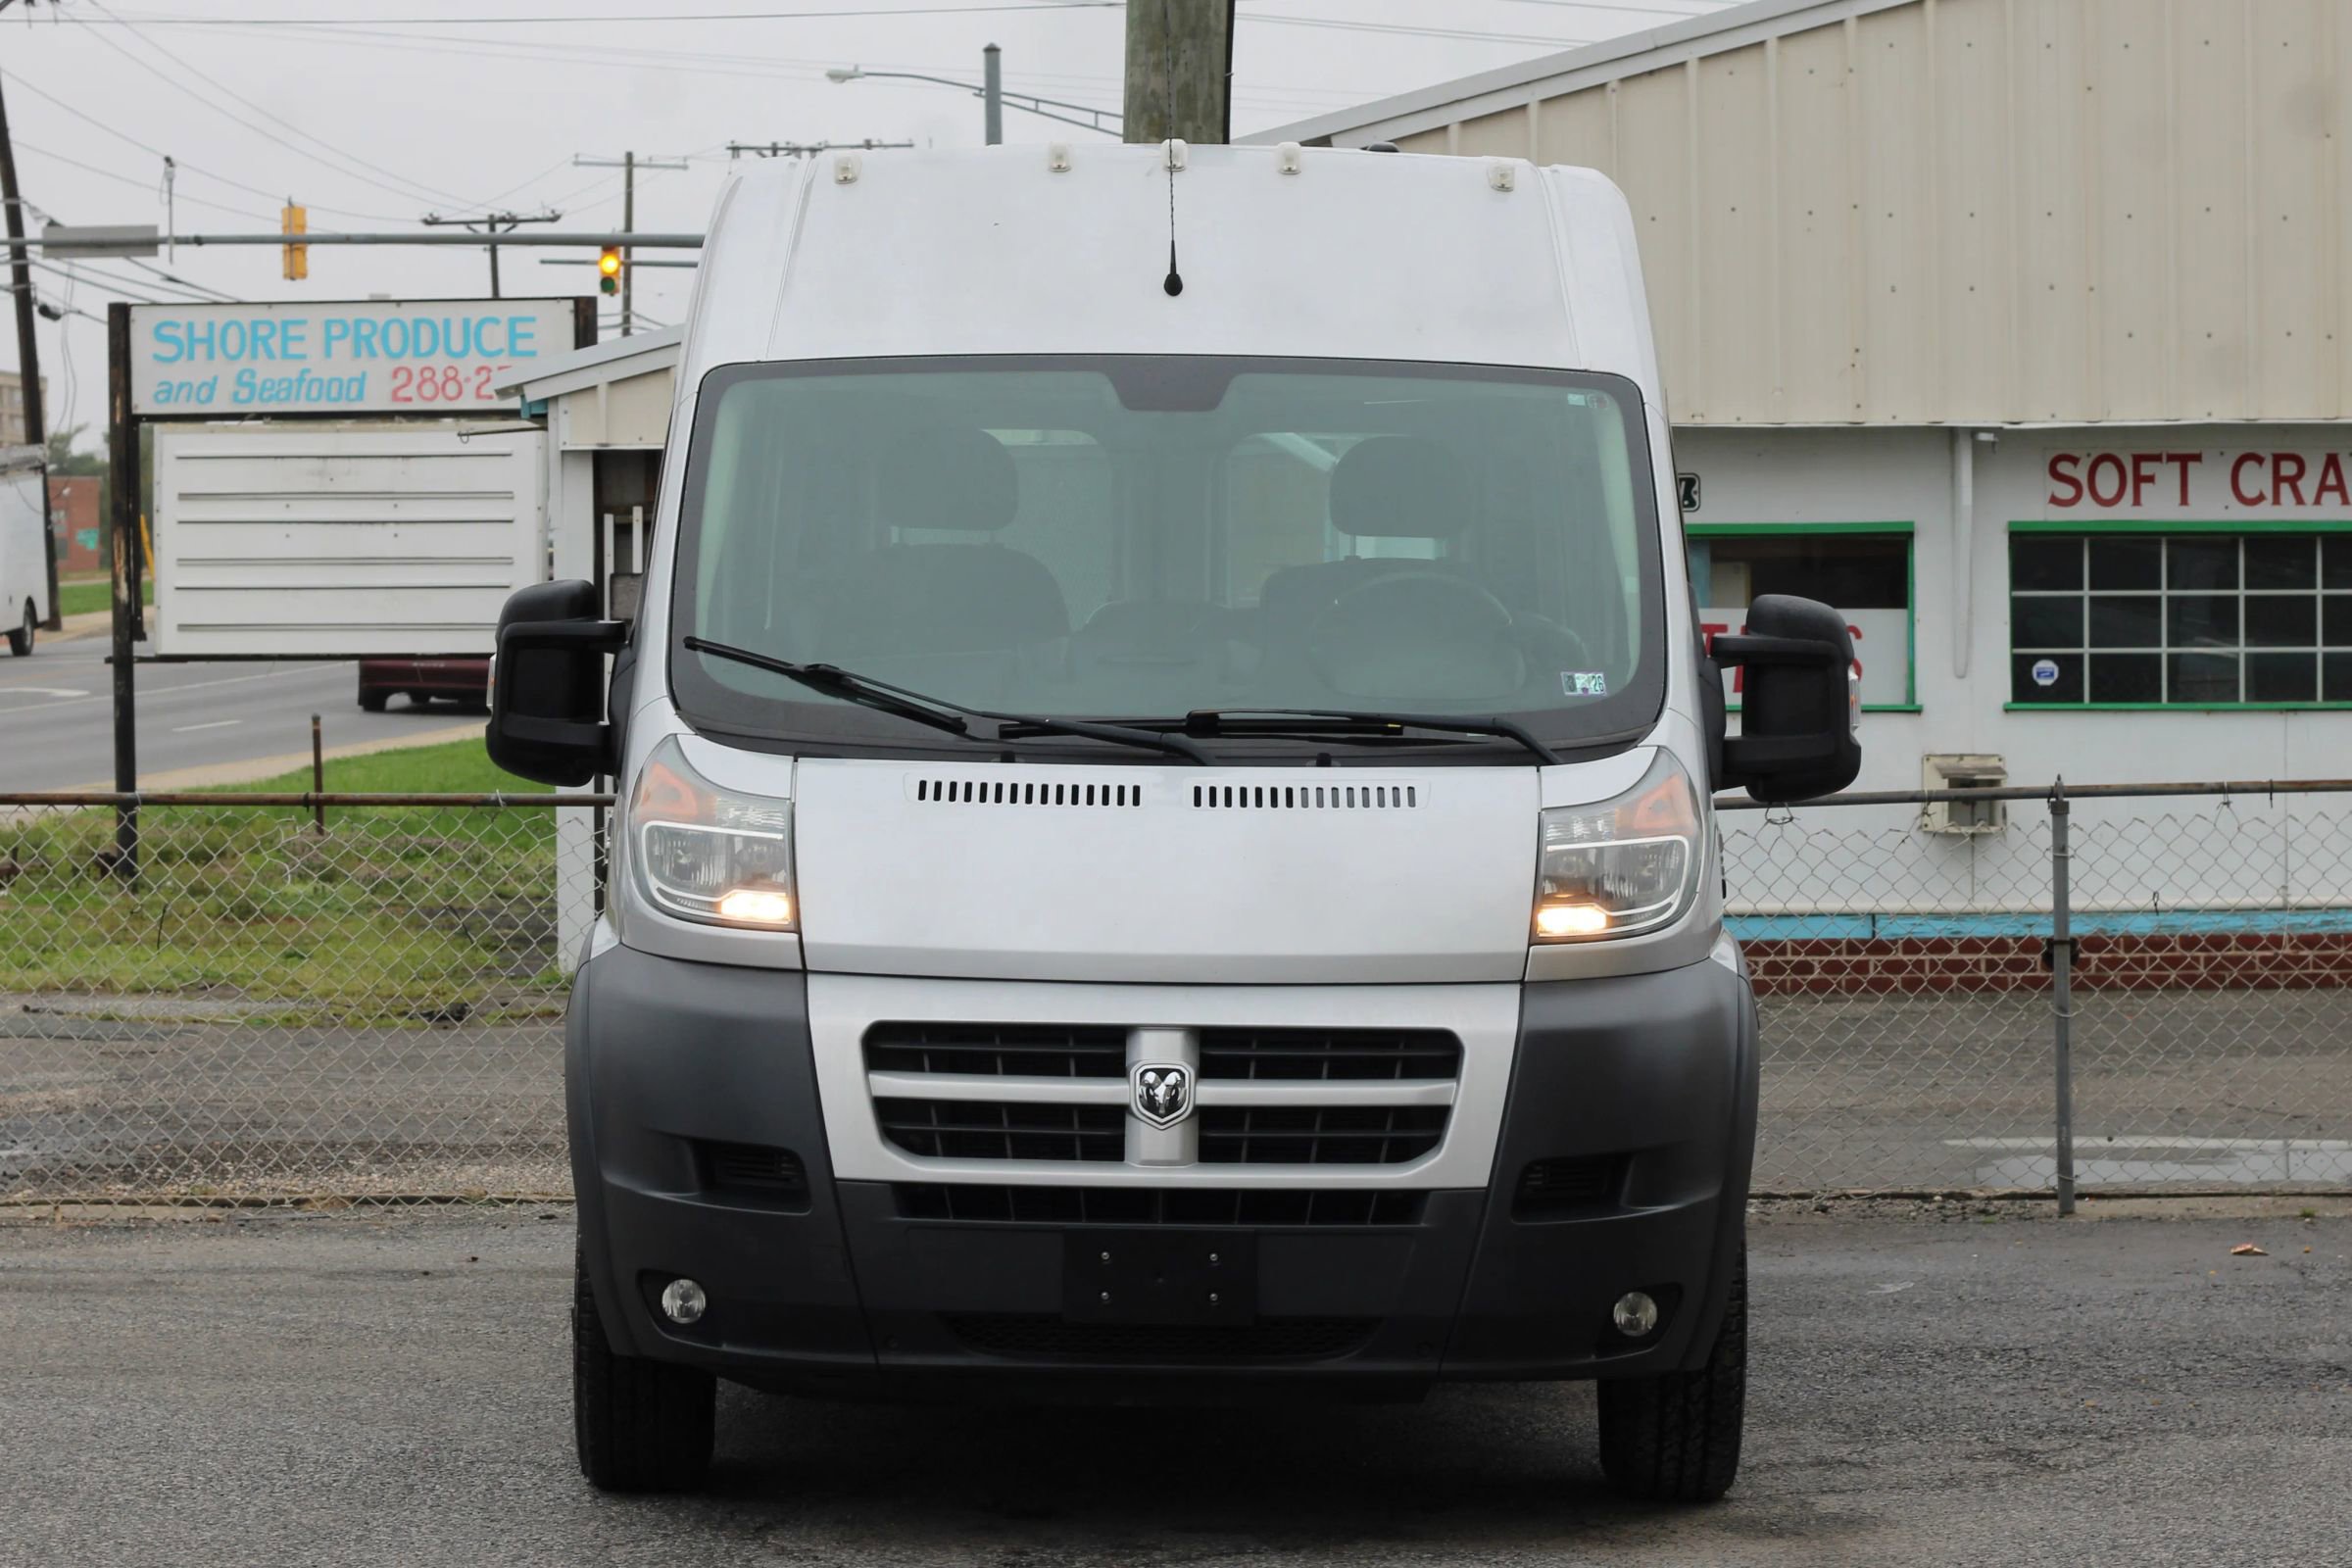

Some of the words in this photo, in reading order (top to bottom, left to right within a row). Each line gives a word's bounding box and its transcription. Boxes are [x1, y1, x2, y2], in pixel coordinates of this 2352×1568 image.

[153, 318, 309, 363] SHORE
[323, 316, 538, 359] PRODUCE
[153, 375, 219, 404] and
[231, 368, 367, 404] Seafood
[2048, 452, 2203, 508] SOFT
[2230, 452, 2351, 508] CRA
